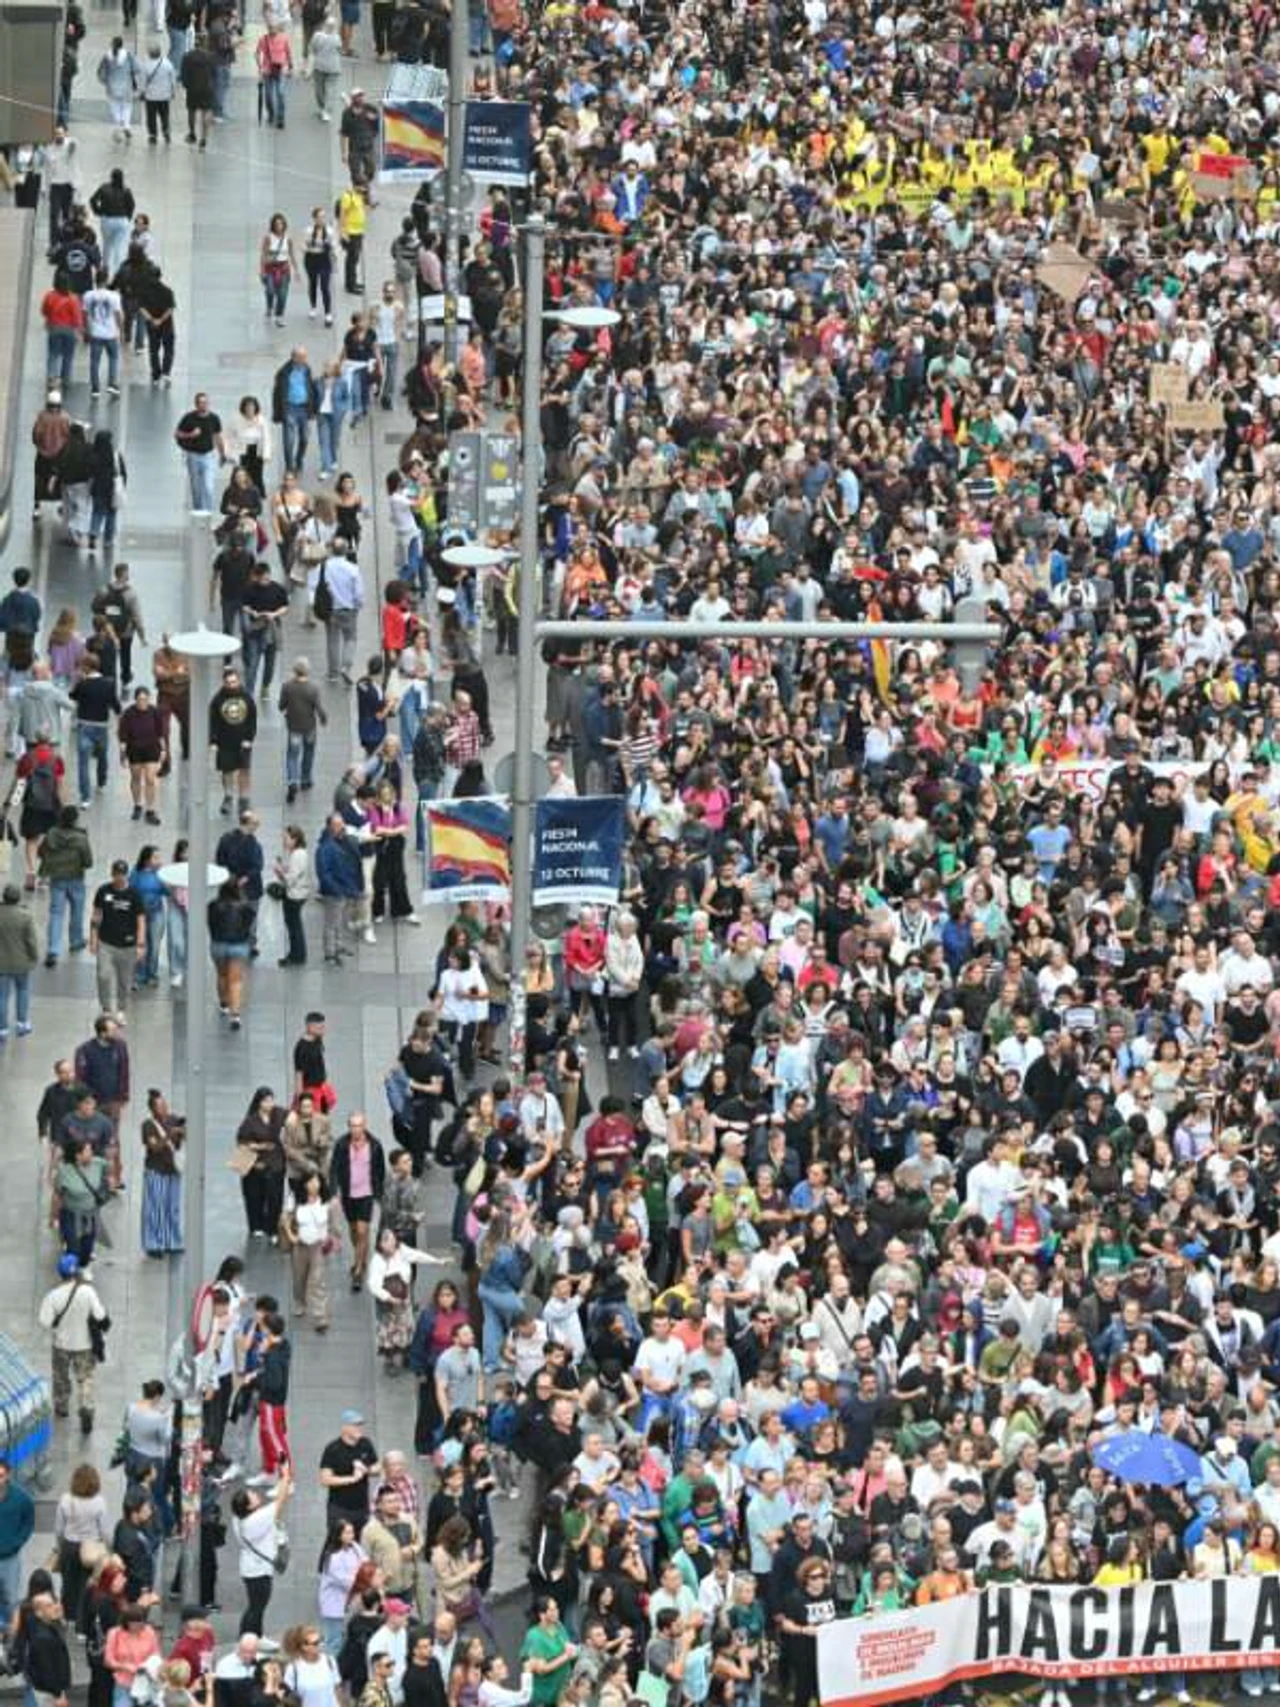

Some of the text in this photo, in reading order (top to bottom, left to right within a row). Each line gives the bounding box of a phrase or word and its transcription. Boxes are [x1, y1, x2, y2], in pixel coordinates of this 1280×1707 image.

[541, 827, 577, 840] FIESTA
[541, 840, 601, 853] NACIONAL
[554, 866, 611, 881] OCTUBRE
[975, 1585, 1181, 1660] HACIA
[992, 1656, 1070, 1676] BAJADA
[1081, 1662, 1116, 1674] DEL
[1126, 1656, 1226, 1672] ALQUILER
